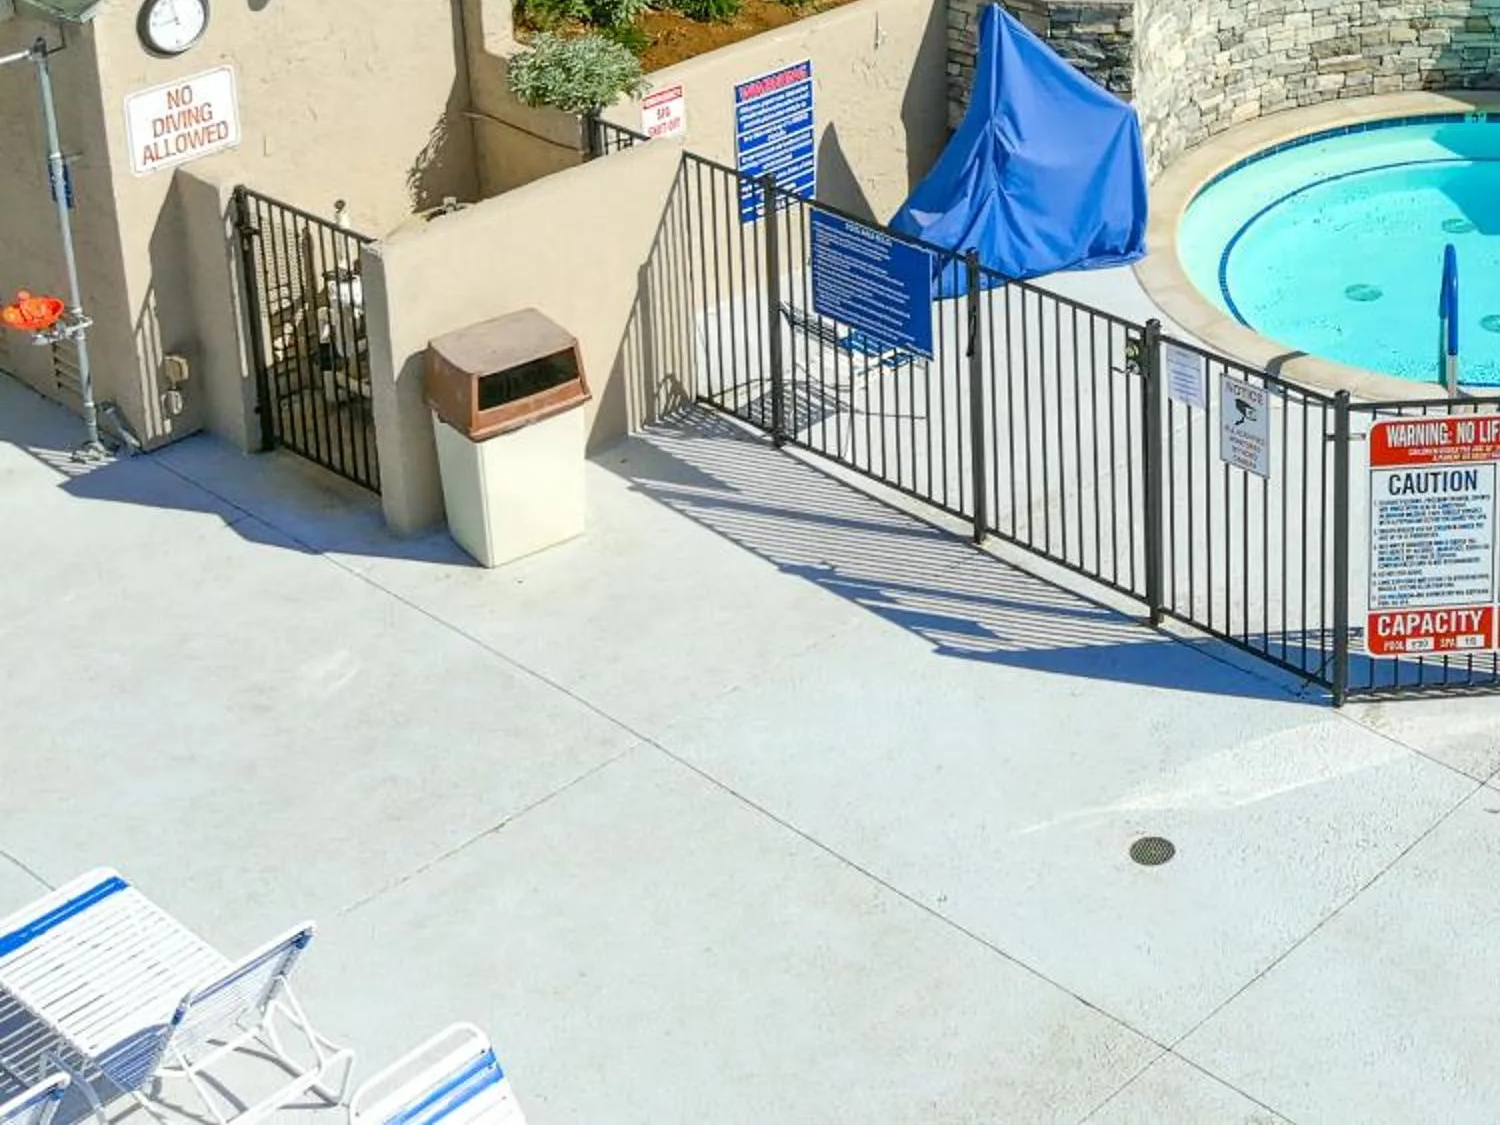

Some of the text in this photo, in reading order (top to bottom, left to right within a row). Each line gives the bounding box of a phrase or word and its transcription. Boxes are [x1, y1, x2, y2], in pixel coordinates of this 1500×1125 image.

[166, 84, 193, 110] NO
[152, 102, 213, 139] DIVING
[143, 120, 229, 166] ALLOWED
[1386, 422, 1453, 448] WARNING:
[1456, 421, 1475, 444] NO
[1388, 469, 1478, 496] CAUTION
[1377, 610, 1483, 636] CAPACITY
